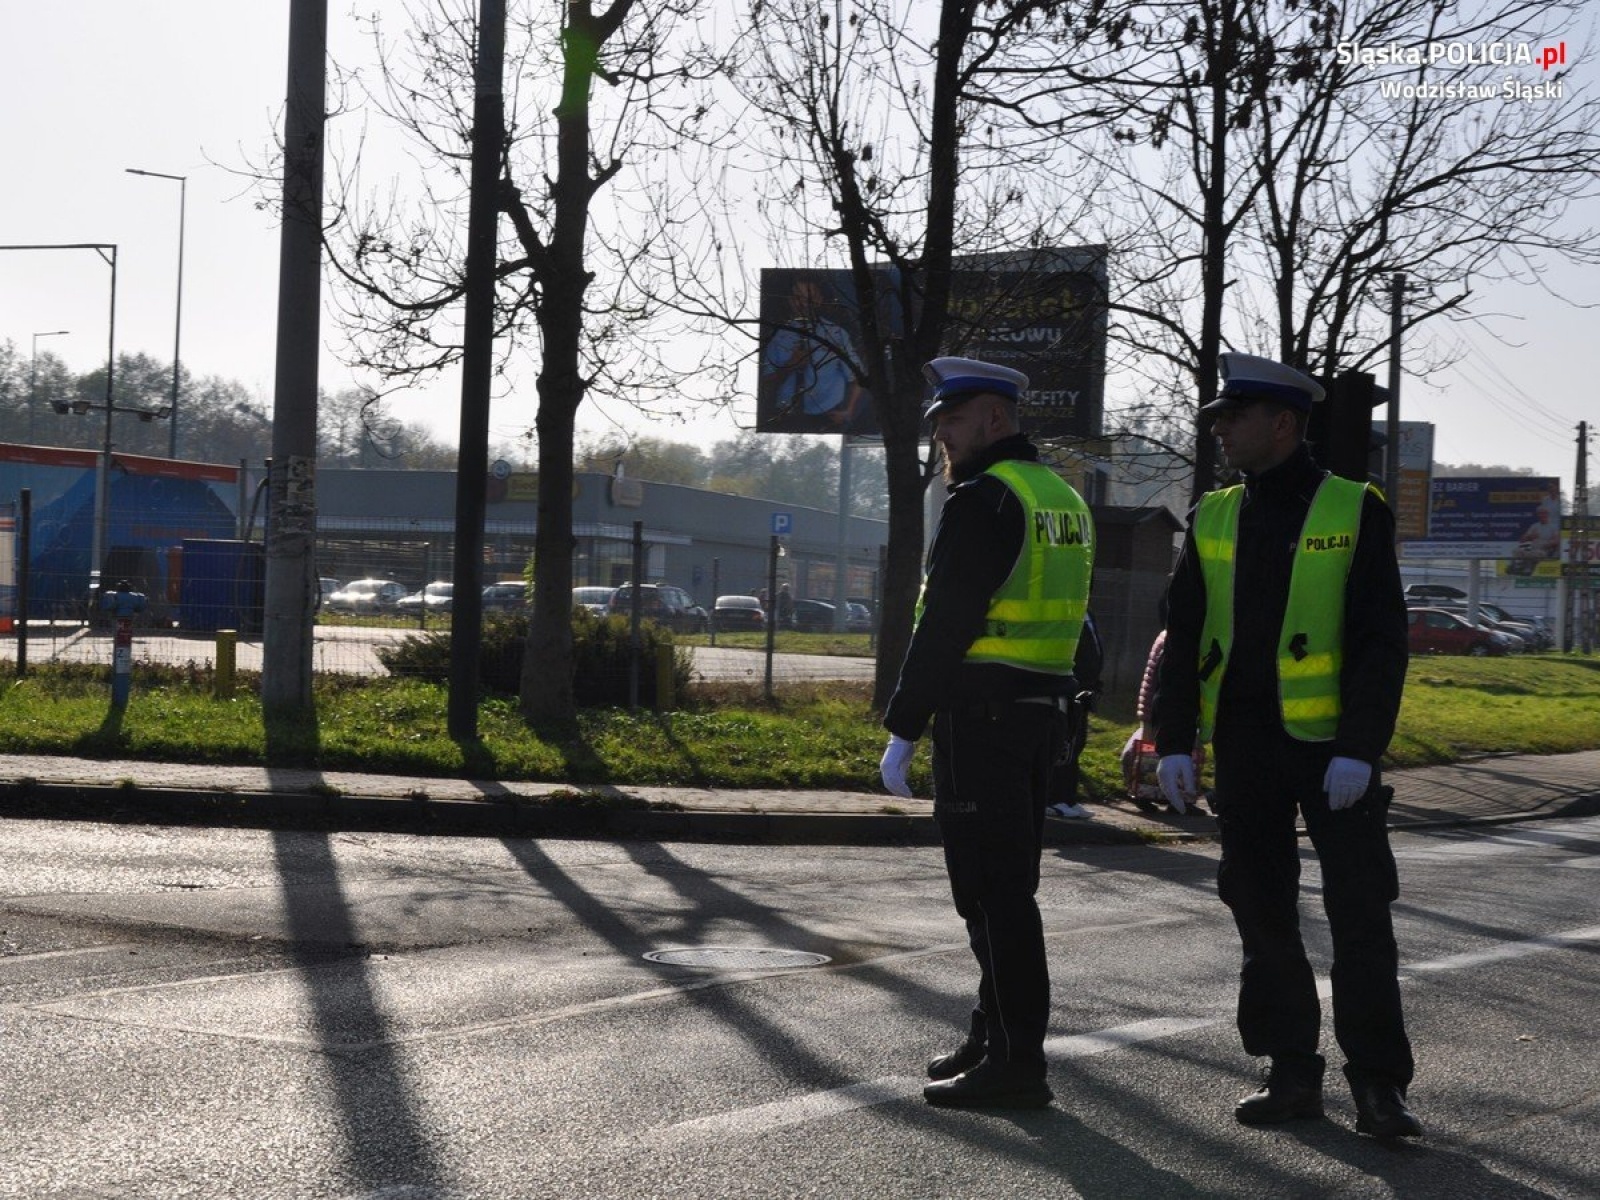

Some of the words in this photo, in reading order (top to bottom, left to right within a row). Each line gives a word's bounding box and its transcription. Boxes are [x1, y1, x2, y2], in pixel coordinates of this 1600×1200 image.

[775, 515, 789, 532] P
[1034, 511, 1090, 545] POLICJA
[1306, 535, 1350, 551] POLICJA
[939, 800, 978, 814] LICJA
